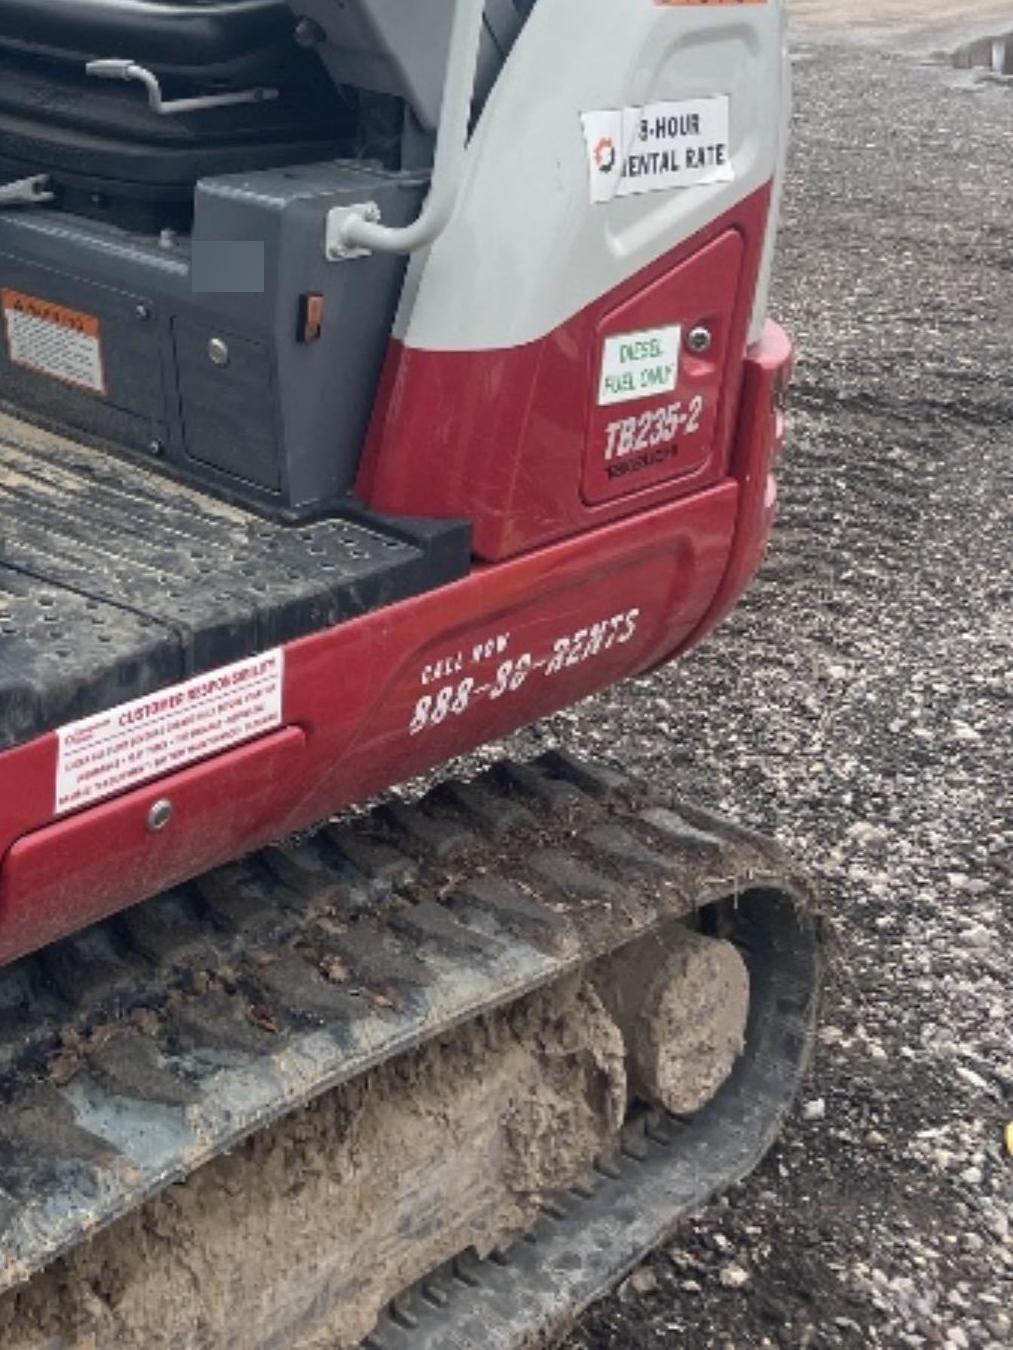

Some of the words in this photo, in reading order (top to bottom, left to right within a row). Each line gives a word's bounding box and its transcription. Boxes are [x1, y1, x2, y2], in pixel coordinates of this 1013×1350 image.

[686, 143, 726, 169] RATE
[604, 371, 636, 394] FUEL
[604, 394, 703, 460] TB235-2
[421, 650, 463, 685] CALL
